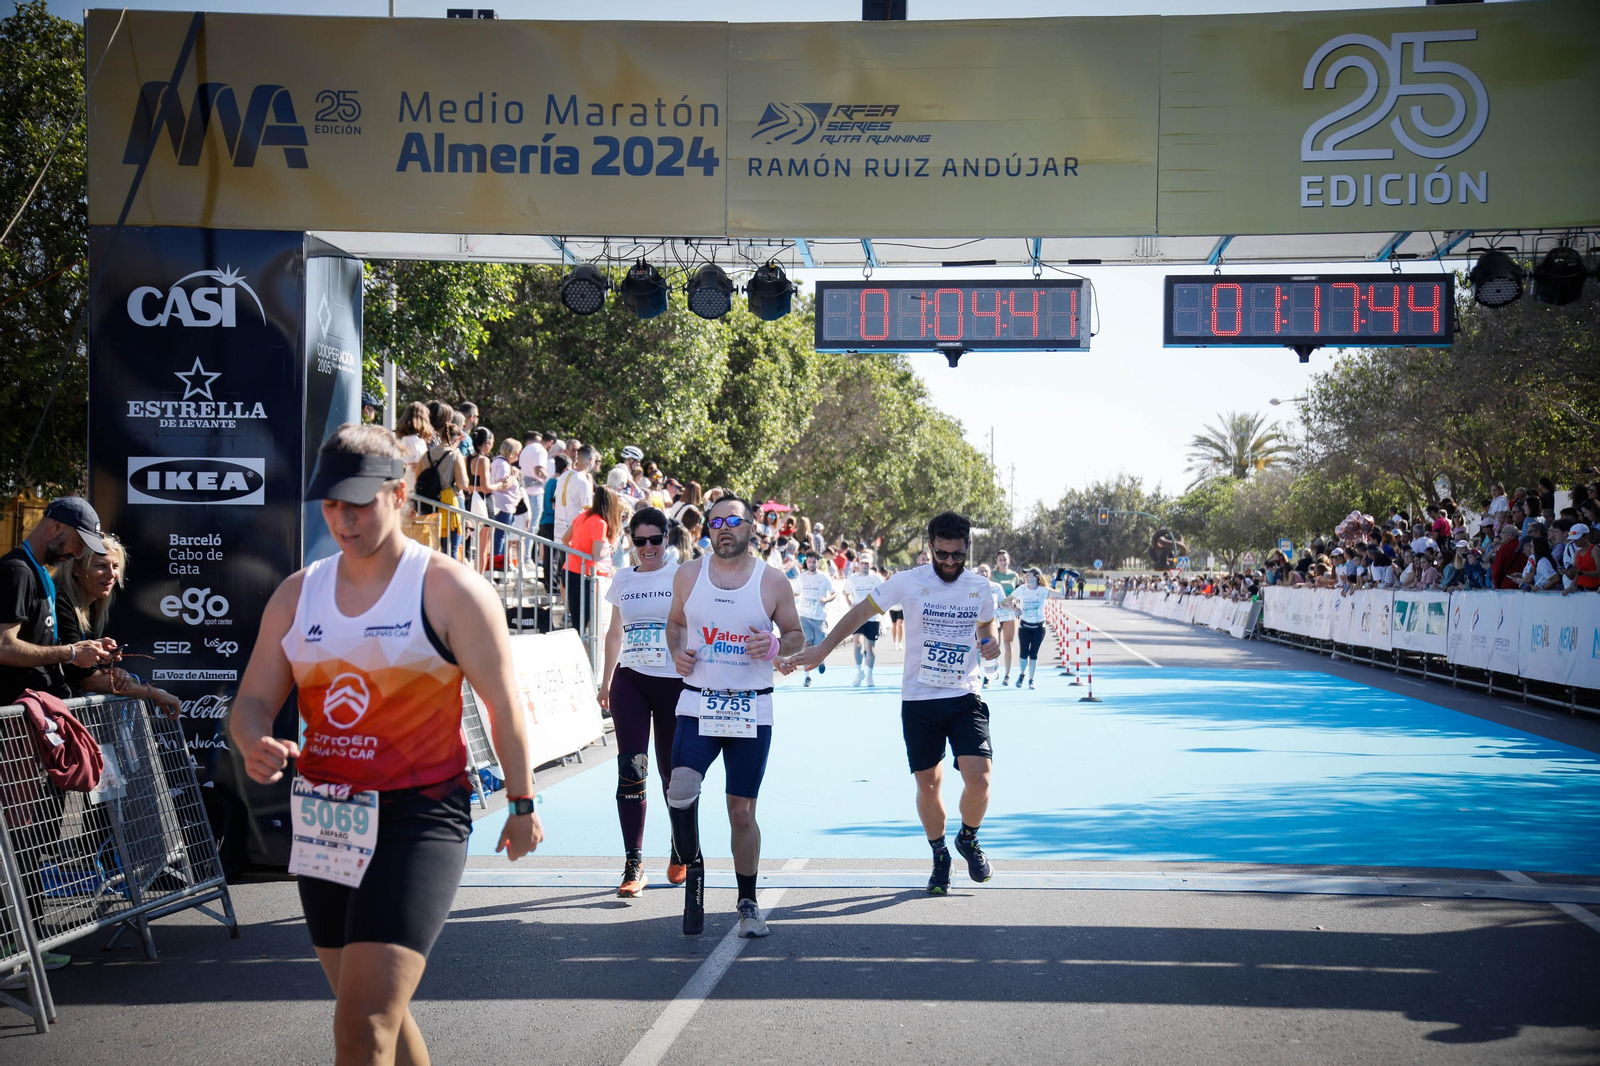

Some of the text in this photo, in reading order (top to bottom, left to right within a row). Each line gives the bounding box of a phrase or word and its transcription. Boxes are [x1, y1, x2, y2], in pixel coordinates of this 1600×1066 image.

[1301, 28, 1490, 161] 25
[315, 90, 362, 122] 25
[398, 91, 719, 127] Medio Maratón
[833, 105, 900, 120] RFEA
[314, 123, 362, 135] EDICIÓN
[826, 121, 892, 133] SERIES
[820, 135, 931, 145] RUTA RUNNING
[396, 132, 720, 177] Almería 2024
[748, 152, 1079, 177] RAMÓN RUIZ ANDÚJAR
[1301, 163, 1489, 208] EDICIÓN
[127, 285, 237, 328] CASI
[126, 400, 268, 419] ESTRELLA
[159, 419, 236, 428] DE LEVANTE
[147, 471, 249, 491] IKEA
[169, 533, 222, 546] Barceló
[168, 548, 223, 560] Cabo de
[168, 562, 201, 575] Gata
[620, 590, 672, 601] COSENTINO
[159, 587, 229, 626] ego
[923, 602, 946, 610] Medio
[922, 609, 978, 619] Almería 2024
[204, 618, 217, 626] sport
[627, 629, 660, 645] 5281
[153, 641, 191, 654] SER
[927, 648, 965, 665] 5284
[154, 671, 236, 680] La Voz de Almería
[706, 697, 751, 713] 5755
[348, 747, 376, 760] CAR
[301, 797, 369, 835] 5069
